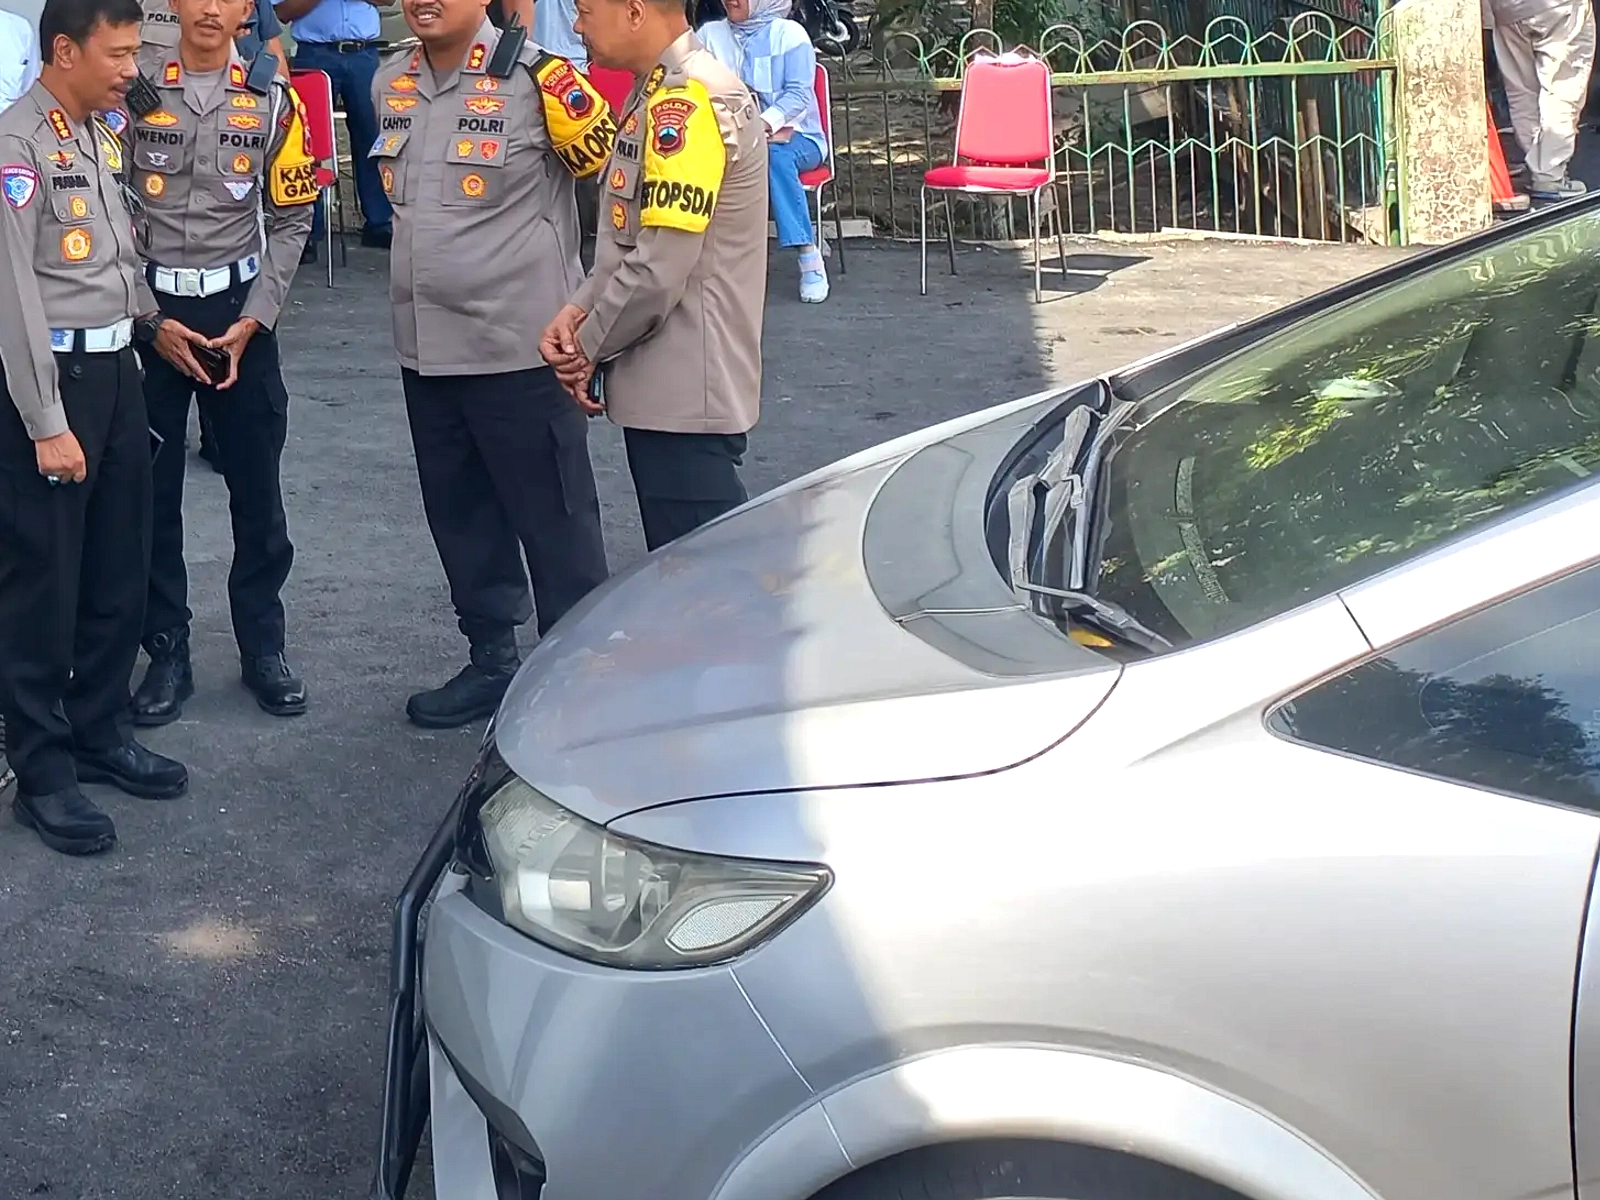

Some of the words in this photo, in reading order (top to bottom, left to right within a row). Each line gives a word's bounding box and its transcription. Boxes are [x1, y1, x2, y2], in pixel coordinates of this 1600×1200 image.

[656, 102, 688, 113] POLDA
[458, 118, 505, 133] POLRI
[137, 129, 184, 145] WENDI
[220, 133, 265, 148] POLRI
